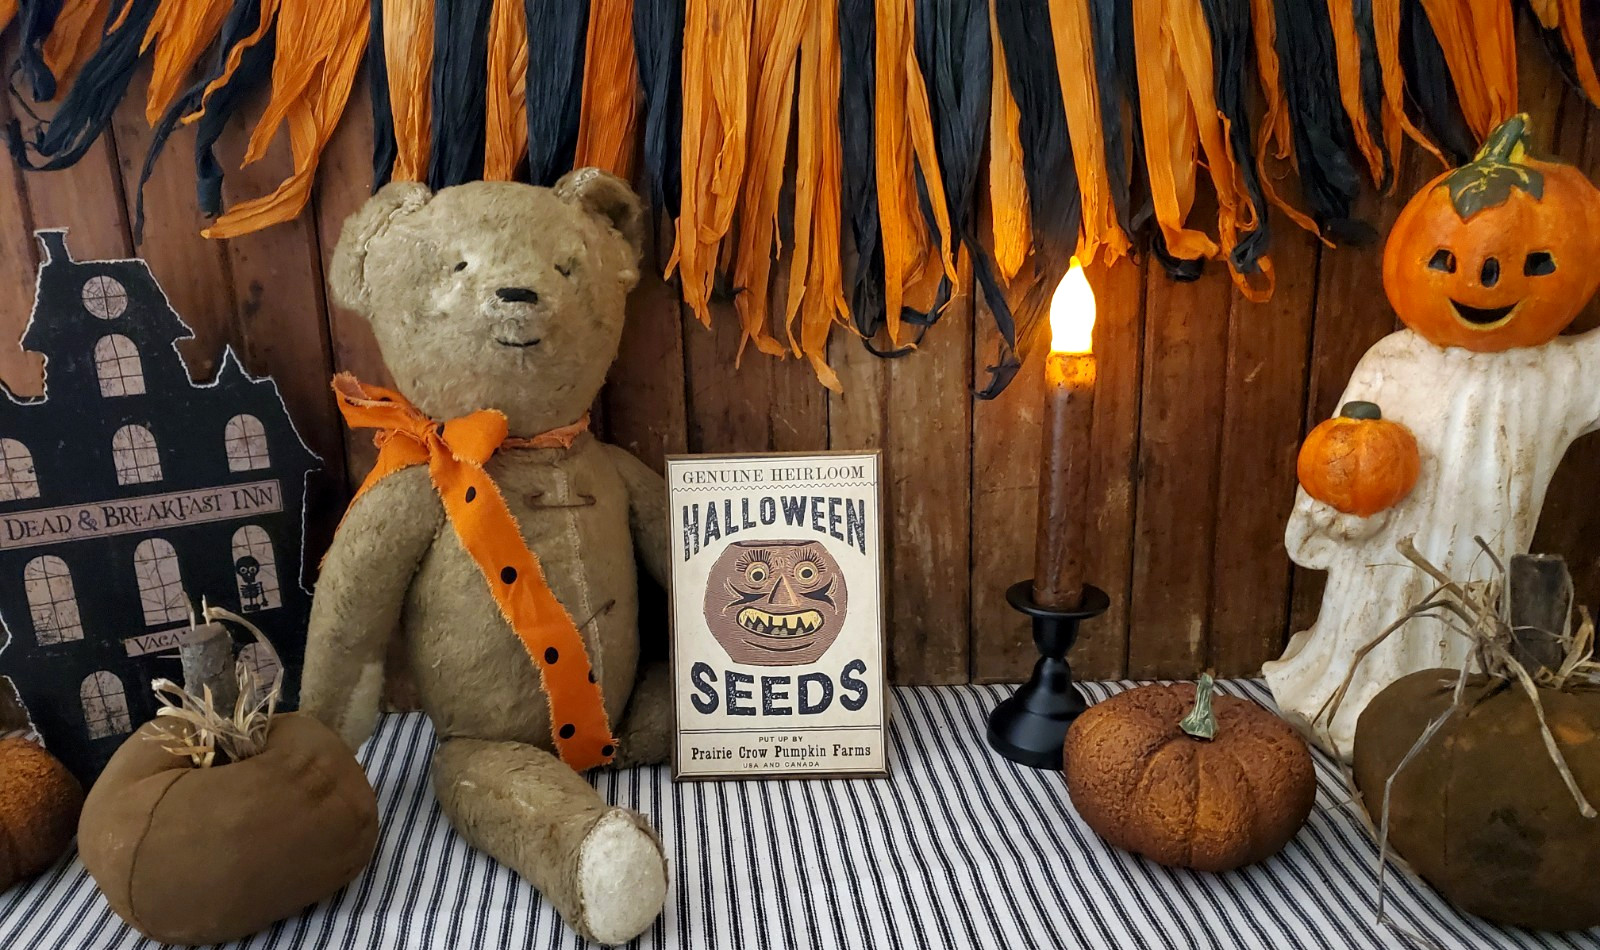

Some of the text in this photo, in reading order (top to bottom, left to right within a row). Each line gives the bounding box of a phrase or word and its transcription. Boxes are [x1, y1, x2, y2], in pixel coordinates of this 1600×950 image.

[682, 465, 865, 484] GENUINE HEIRLOOM
[5, 515, 72, 542] DEAD
[77, 509, 98, 532] &
[231, 486, 273, 510] INN
[682, 495, 867, 562] HALLOWEEN
[134, 630, 187, 651] VACA
[690, 659, 868, 716] SEEDS
[792, 735, 804, 743] BY
[691, 743, 872, 760] Prairie Crow Pumpkin Farms
